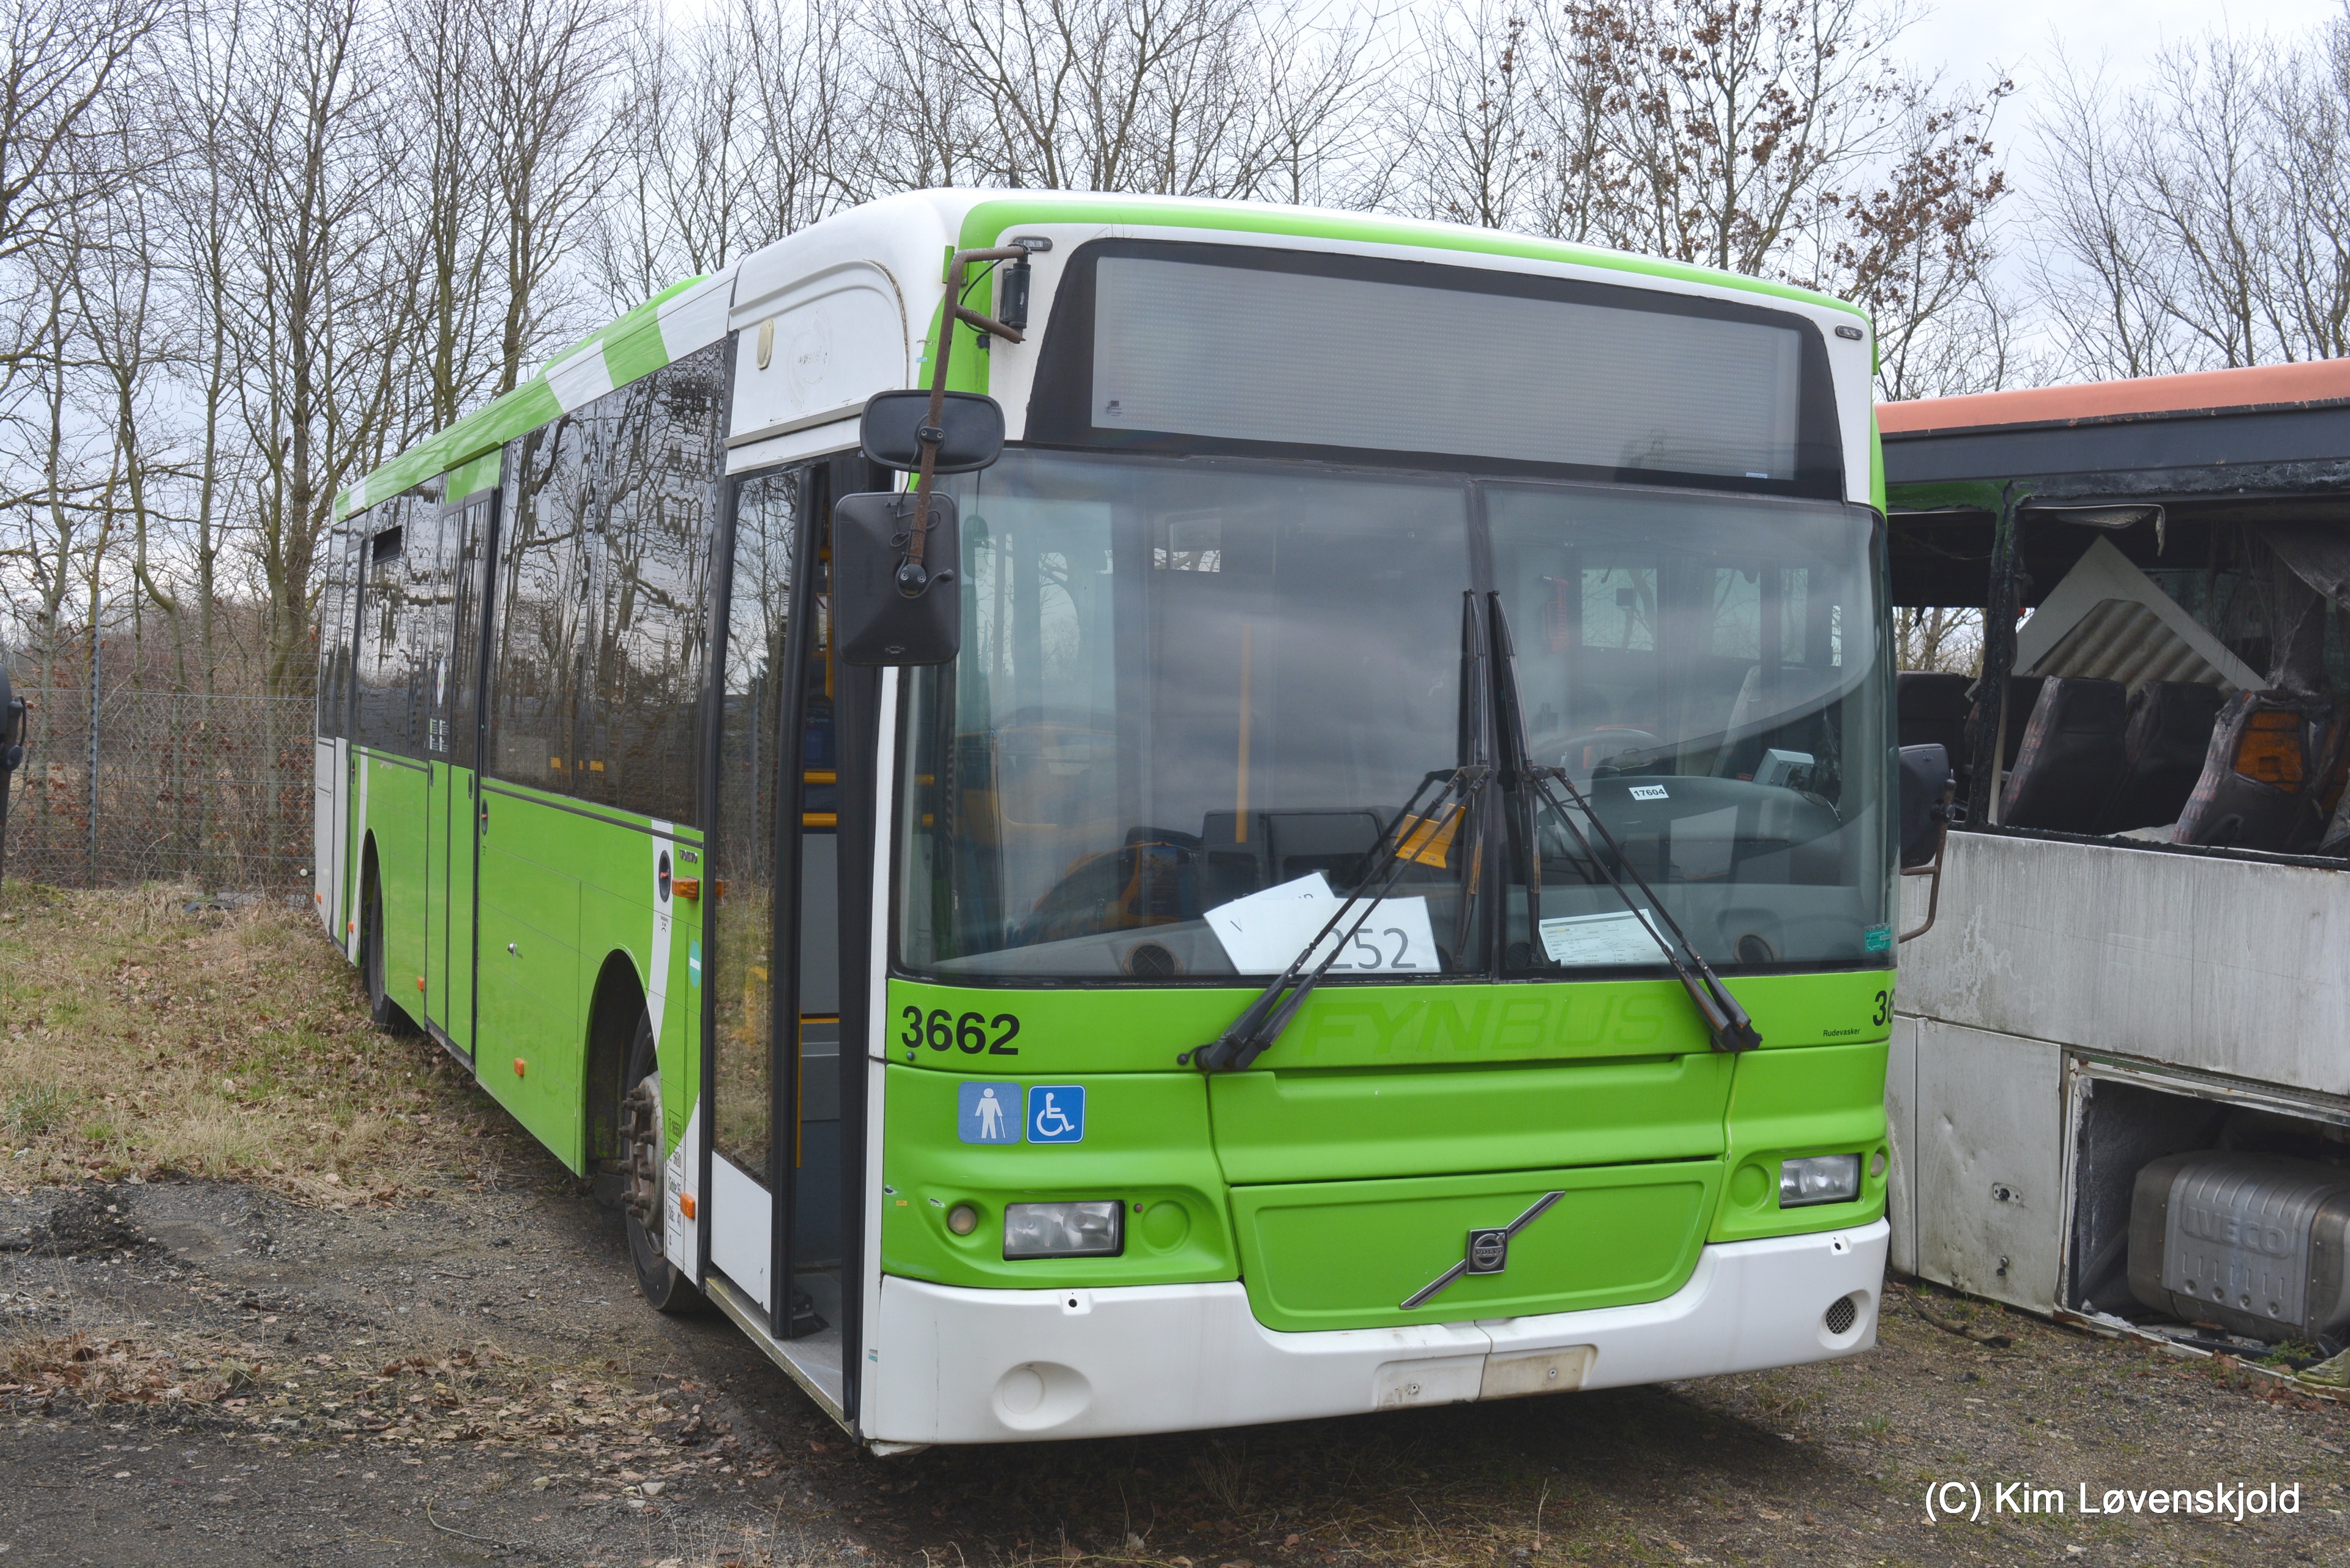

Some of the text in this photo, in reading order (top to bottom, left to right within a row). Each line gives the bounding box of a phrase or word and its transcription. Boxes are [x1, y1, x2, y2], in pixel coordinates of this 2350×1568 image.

[1633, 788, 1665, 797] 17604
[901, 1005, 1021, 1056] 3662
[1299, 993, 1671, 1057] FYNBUS
[1822, 1028, 1861, 1037] Rudevasker
[2186, 1206, 2288, 1255] IVECO
[1474, 1248, 1504, 1256] VOLVO
